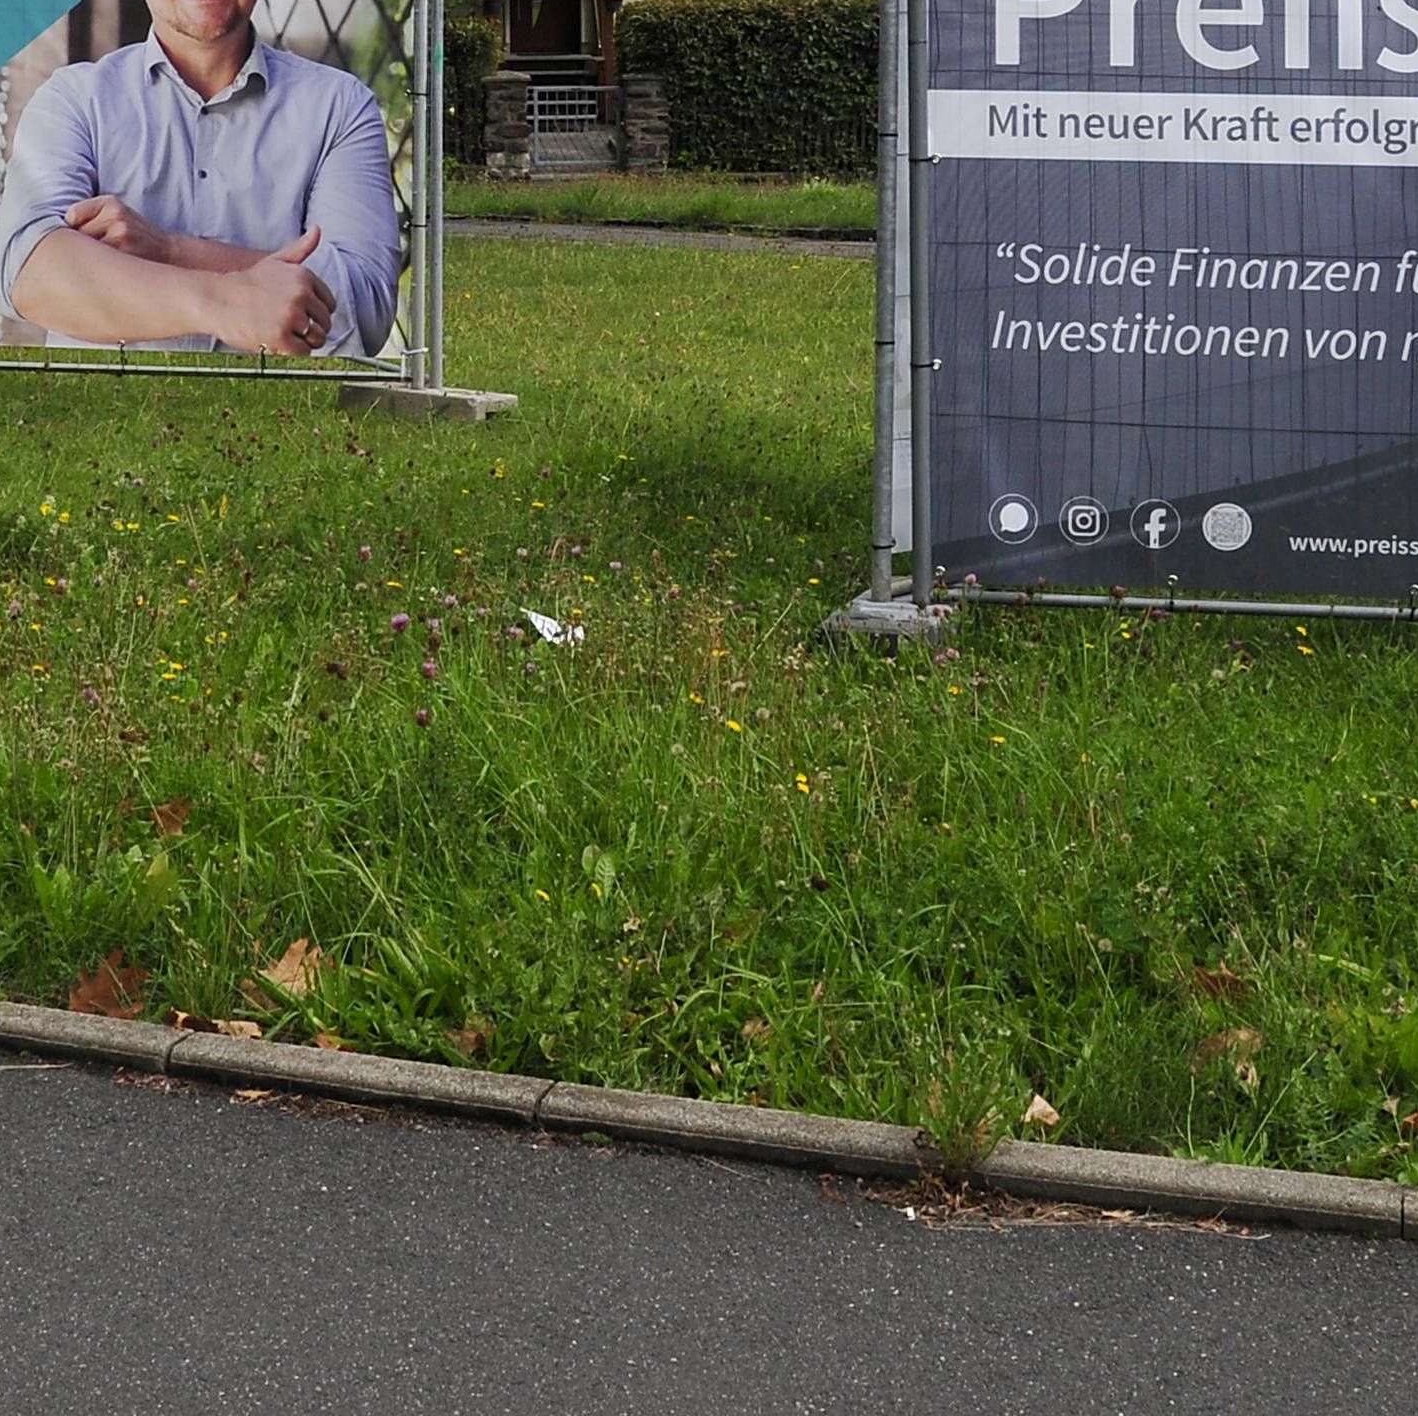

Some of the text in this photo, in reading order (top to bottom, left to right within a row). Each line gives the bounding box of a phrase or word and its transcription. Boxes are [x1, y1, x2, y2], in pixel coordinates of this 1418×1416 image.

[987, 104, 1047, 140] Mit
[1059, 112, 1172, 141] neuer
[1182, 105, 1279, 143] Kraft
[995, 242, 1156, 286] “Solide
[1169, 247, 1381, 293] Finanzen
[991, 309, 1290, 357] Investitionen
[1305, 326, 1387, 360] von
